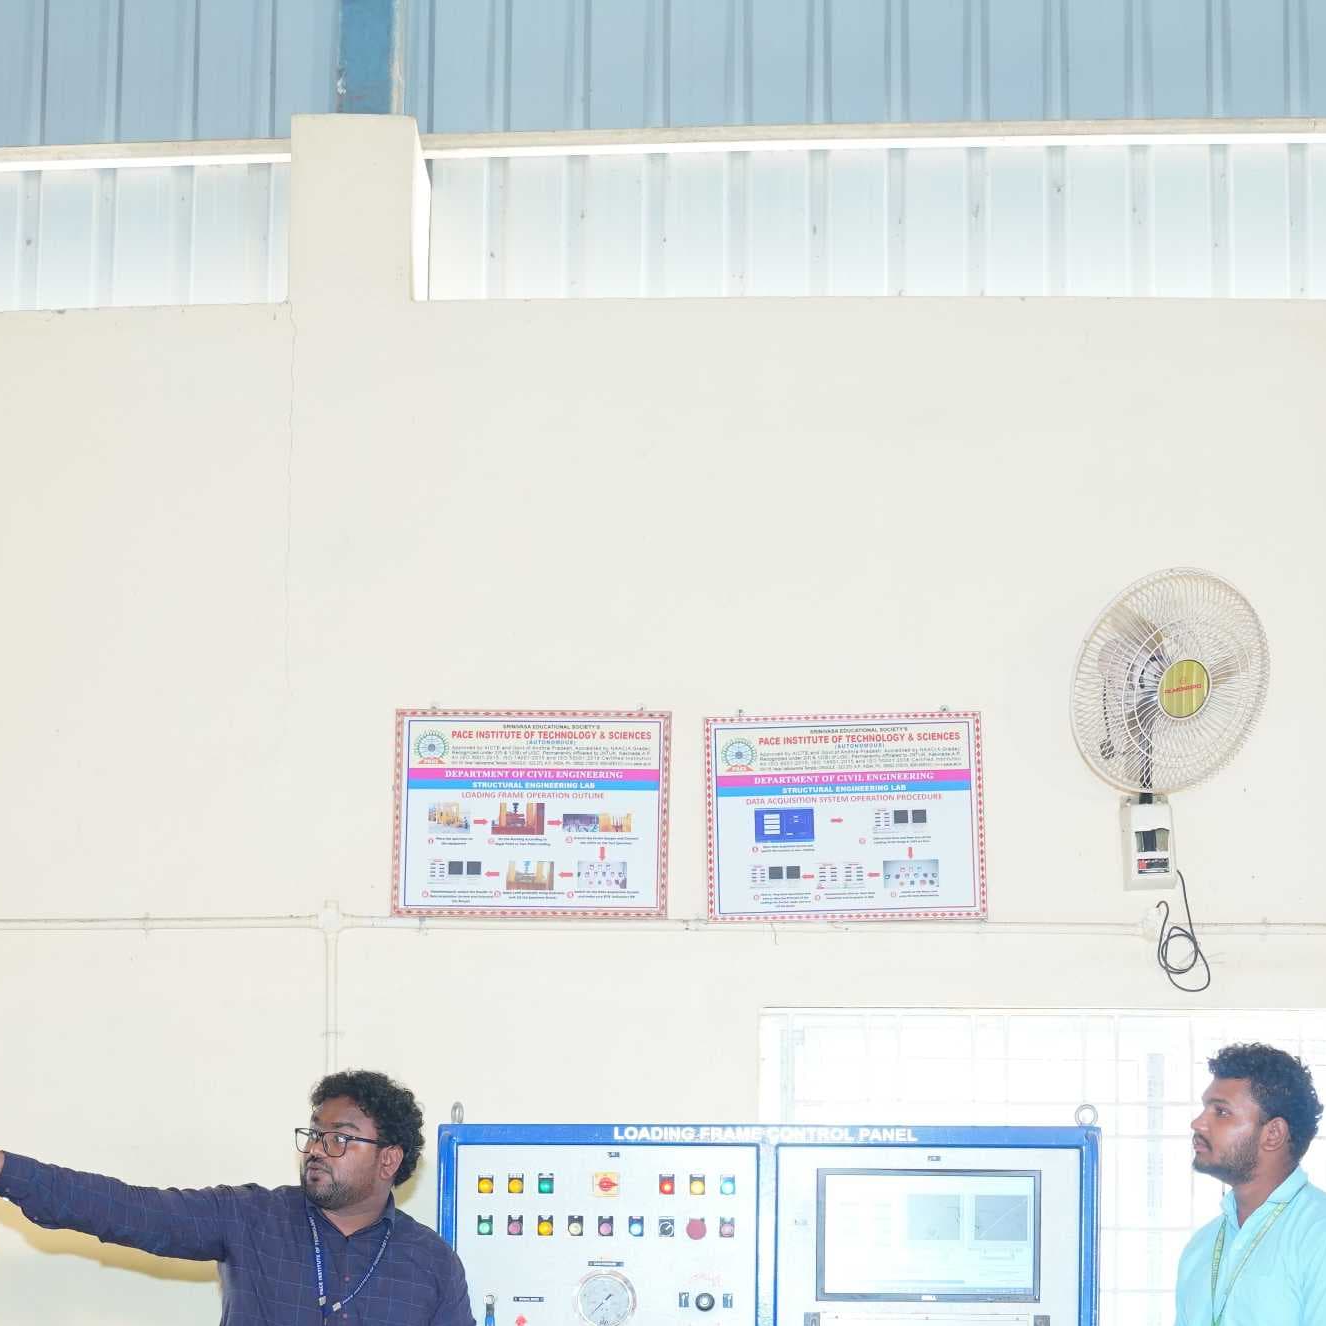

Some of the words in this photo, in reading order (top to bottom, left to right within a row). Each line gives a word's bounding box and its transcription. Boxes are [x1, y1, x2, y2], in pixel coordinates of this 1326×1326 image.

[451, 730, 473, 738] PACE
[476, 730, 521, 739] INSTITUTE
[523, 731, 536, 740] OF
[537, 730, 596, 740] TECHNOLOGY
[608, 731, 651, 739] SCIENCES
[758, 736, 780, 745] PACE
[783, 735, 829, 744] INSTITUTE
[831, 735, 842, 744] OF
[845, 733, 905, 744] TECHNOLOGY
[907, 733, 913, 741] &
[916, 731, 960, 740] SCIENCES
[755, 776, 819, 784] DEPARTMENT
[867, 773, 934, 781] ENGINEERING
[613, 1126, 696, 1140] LOADING
[700, 1127, 762, 1140] FRAME
[768, 1127, 854, 1141] CONTROL
[859, 1128, 918, 1142] PANEL
